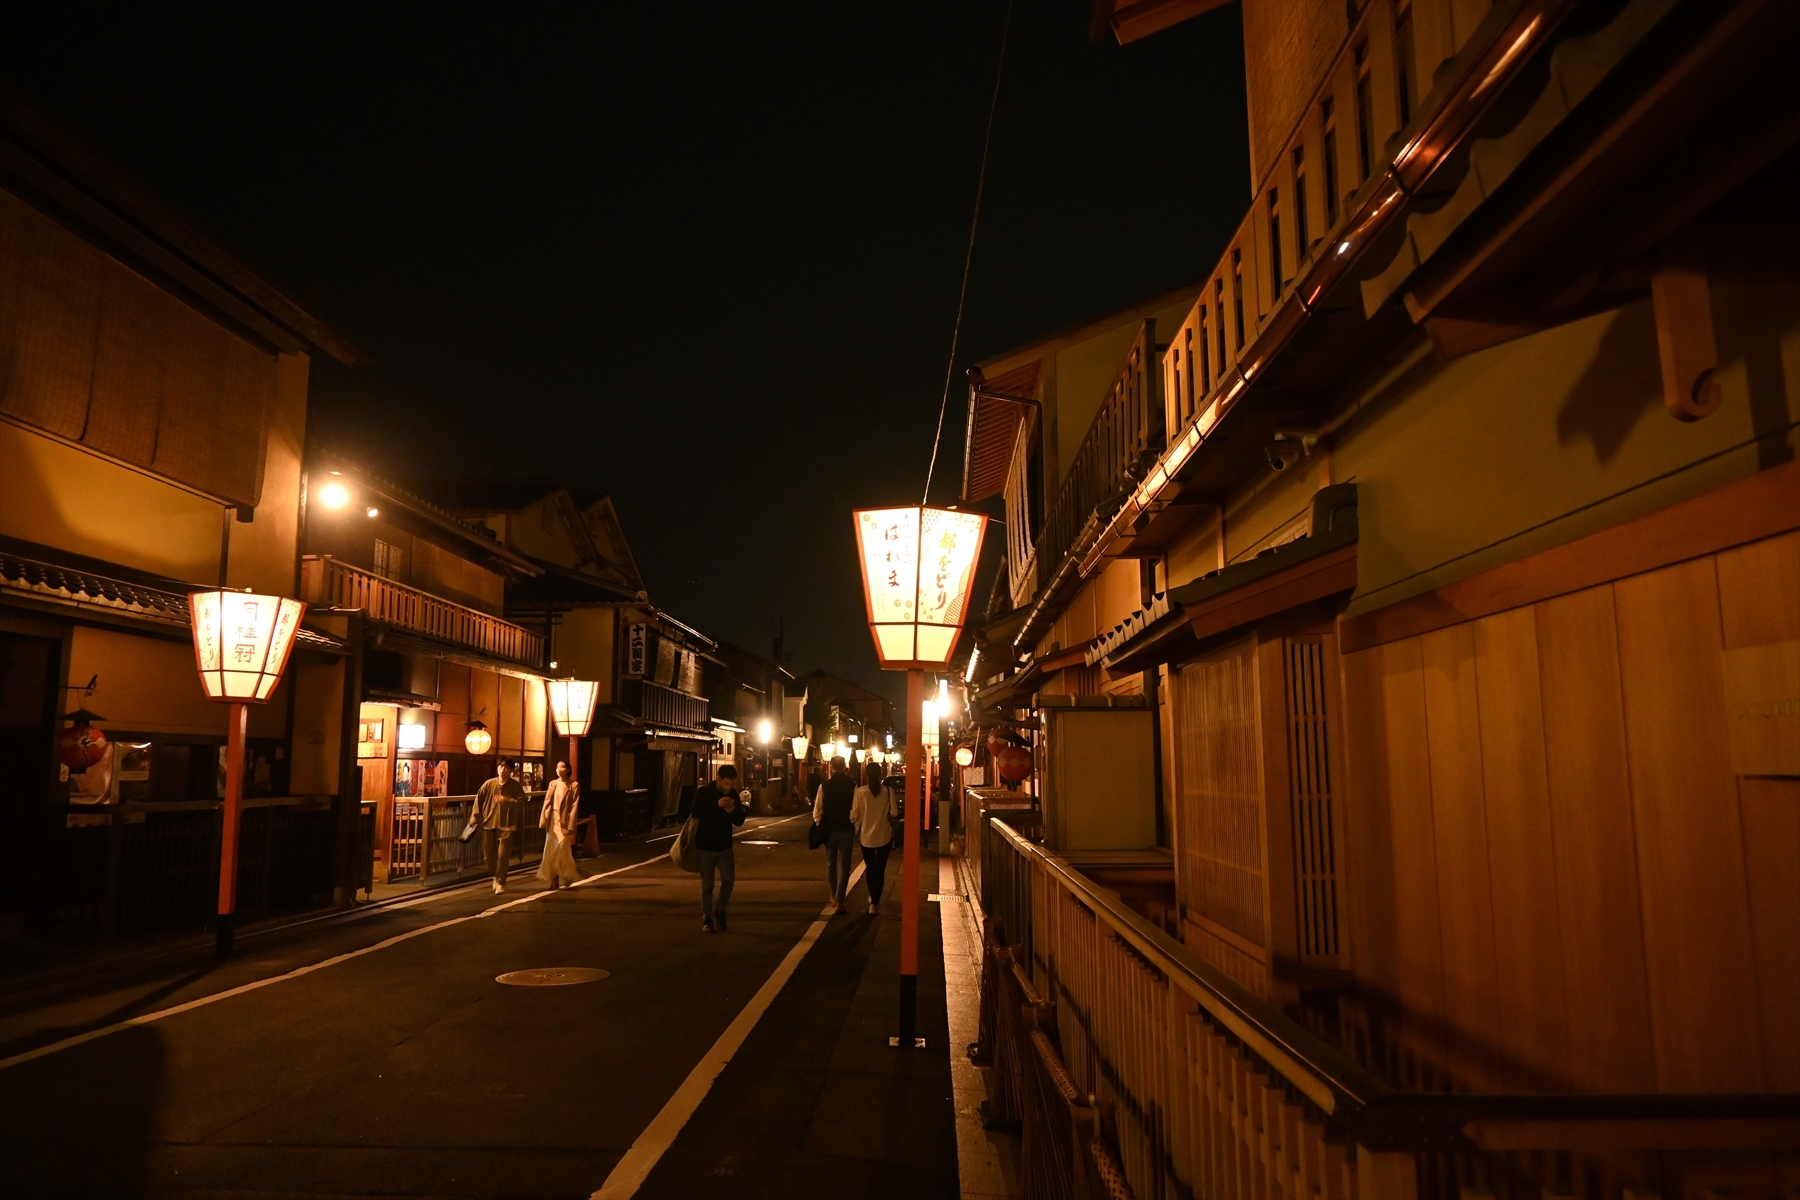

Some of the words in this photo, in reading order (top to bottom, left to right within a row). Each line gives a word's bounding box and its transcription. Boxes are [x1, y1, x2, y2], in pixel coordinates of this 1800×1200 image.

[885, 524, 901, 588] はれま
[935, 528, 957, 610] 都をどり
[233, 601, 259, 663] 月桂冠
